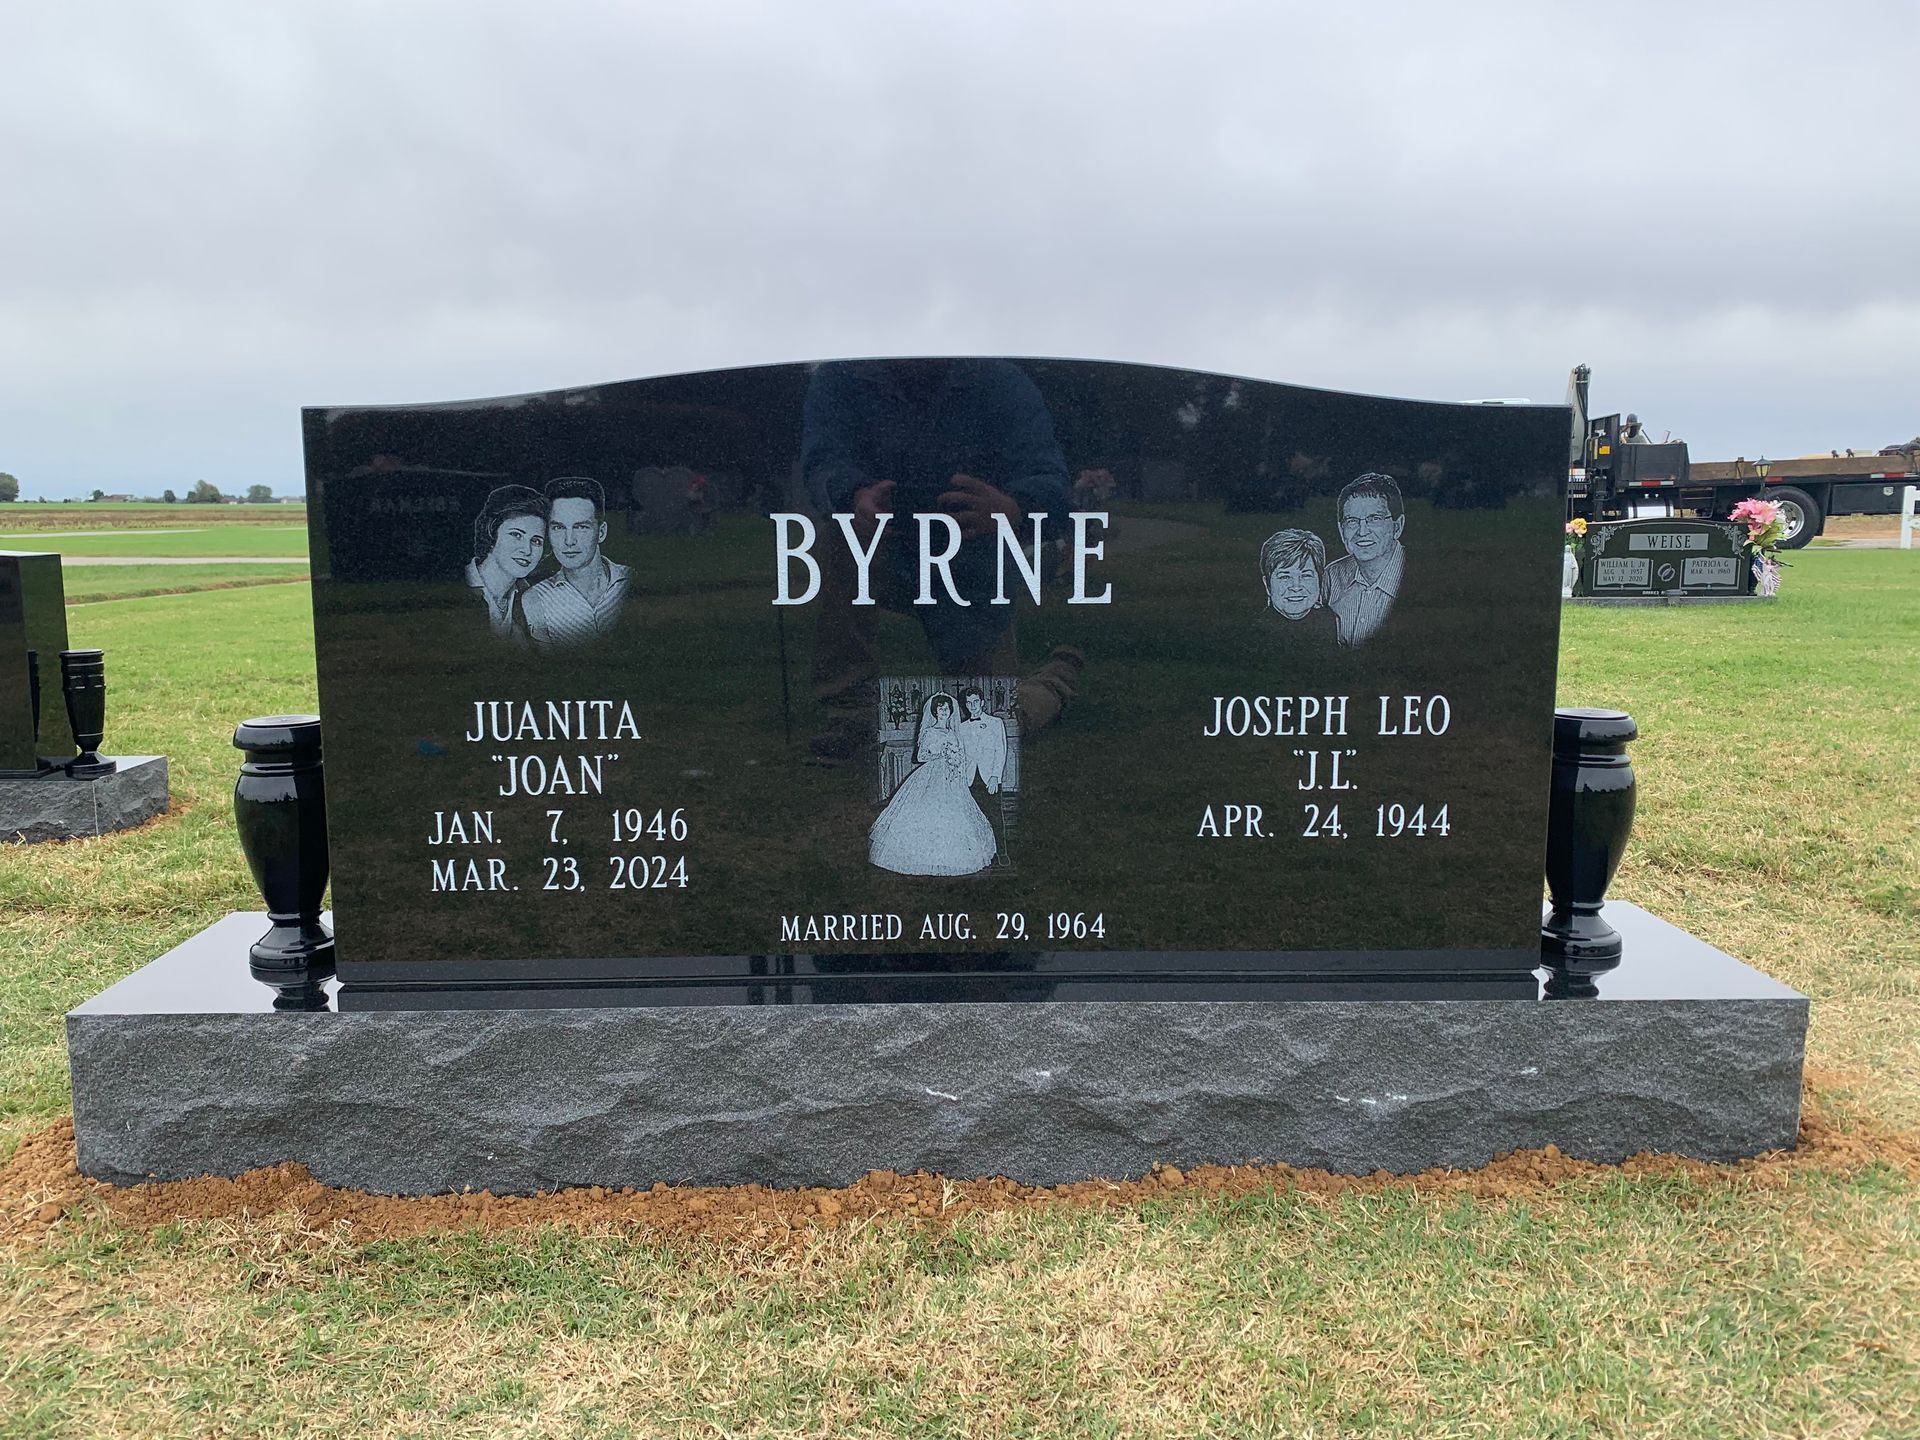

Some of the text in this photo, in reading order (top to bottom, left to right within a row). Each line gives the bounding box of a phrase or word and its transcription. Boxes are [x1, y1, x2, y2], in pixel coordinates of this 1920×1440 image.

[769, 512, 1112, 607] BYRNE
[1646, 534, 1692, 549] WEISE
[1600, 560, 1629, 568] WILLIAM
[466, 699, 642, 742] JUANITA
[1203, 694, 1451, 737] JOSEPH LEO
[428, 808, 688, 845] JAN. 7, 1946
[1196, 803, 1451, 840] APR. 24, 1944
[431, 855, 689, 893] MAR. 23, 2024
[780, 912, 1106, 942] MARRIED AUG. 29, 1964
